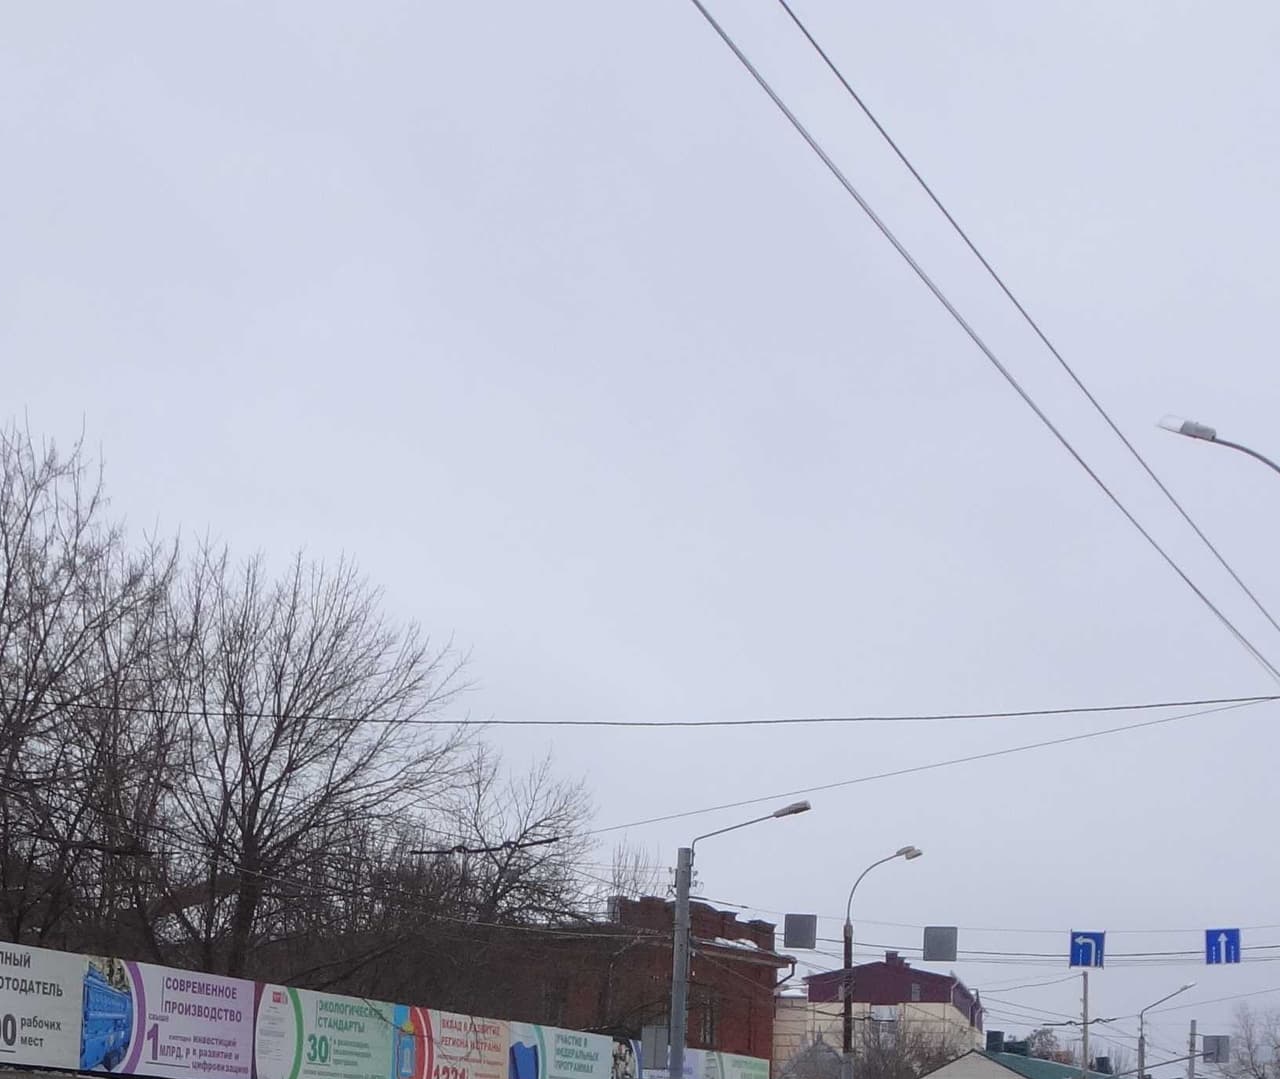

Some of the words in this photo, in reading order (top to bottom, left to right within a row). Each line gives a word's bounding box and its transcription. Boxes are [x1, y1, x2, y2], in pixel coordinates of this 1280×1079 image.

[165, 977, 237, 999] СОВРЕМЕННОЕ
[164, 1000, 242, 1022] ПРОИЗВОДСТВО
[21, 1016, 62, 1031] рабочих
[318, 1017, 365, 1033] СТАНДАРТЫ
[21, 1036, 44, 1047] мест
[147, 1023, 159, 1060] 1
[307, 1034, 329, 1063] 30
[199, 1049, 232, 1060] развитие
